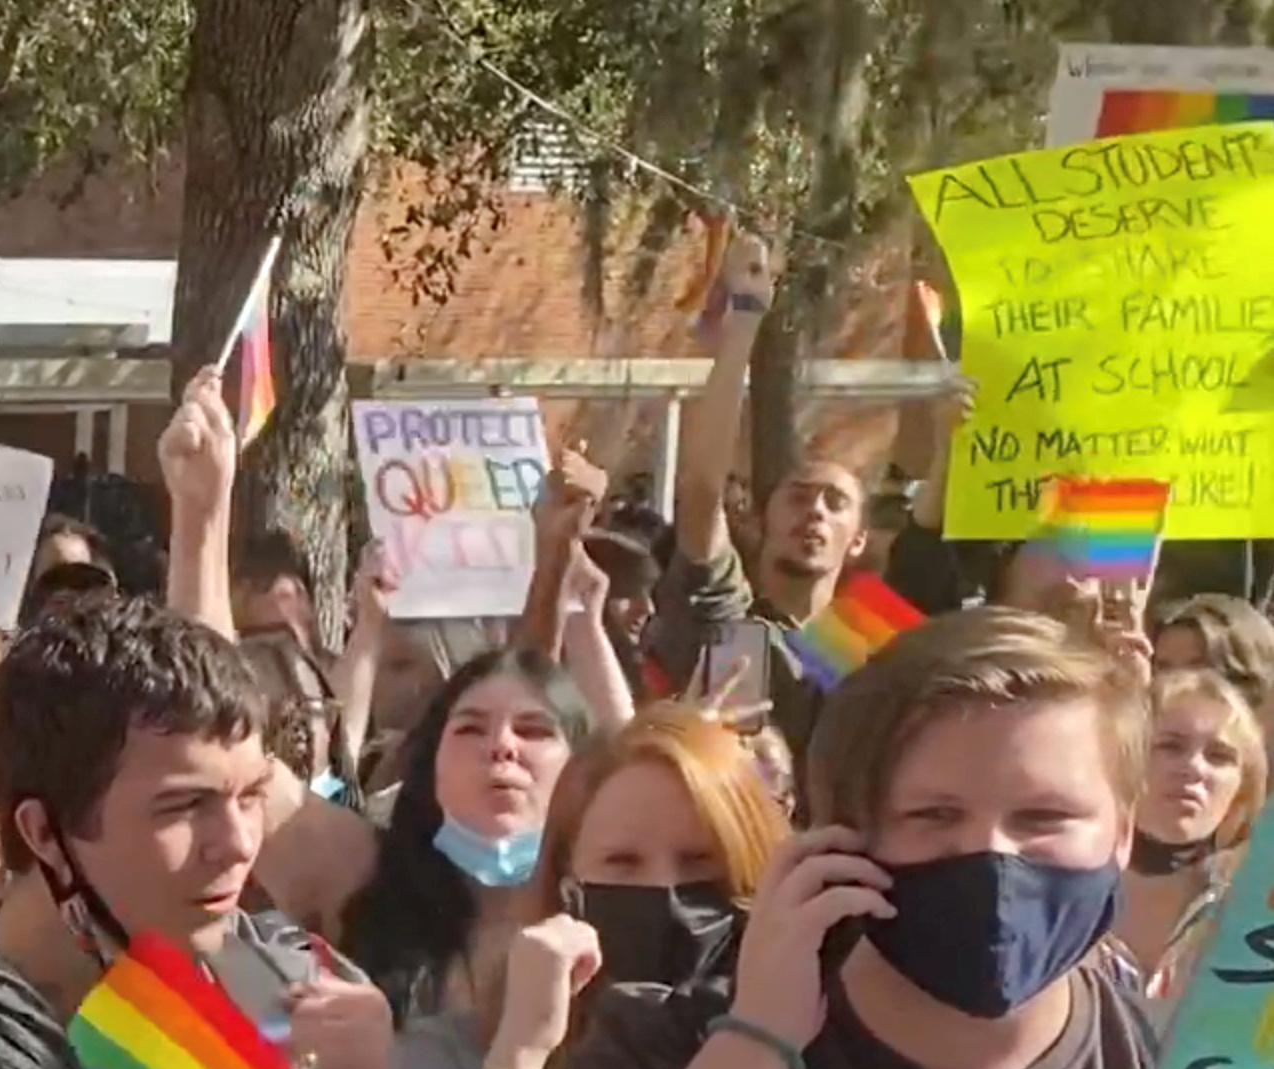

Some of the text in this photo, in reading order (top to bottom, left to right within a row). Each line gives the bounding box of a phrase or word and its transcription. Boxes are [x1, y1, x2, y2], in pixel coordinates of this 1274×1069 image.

[936, 158, 1066, 224] ALL
[1032, 194, 1233, 244] DESERVE
[985, 298, 1094, 338] THEIR
[1005, 348, 1250, 402] AT SCHOOL
[363, 408, 539, 453] PROTECT
[970, 426, 1256, 466] NO MATTER WHAT
[376, 455, 546, 520] QUEER
